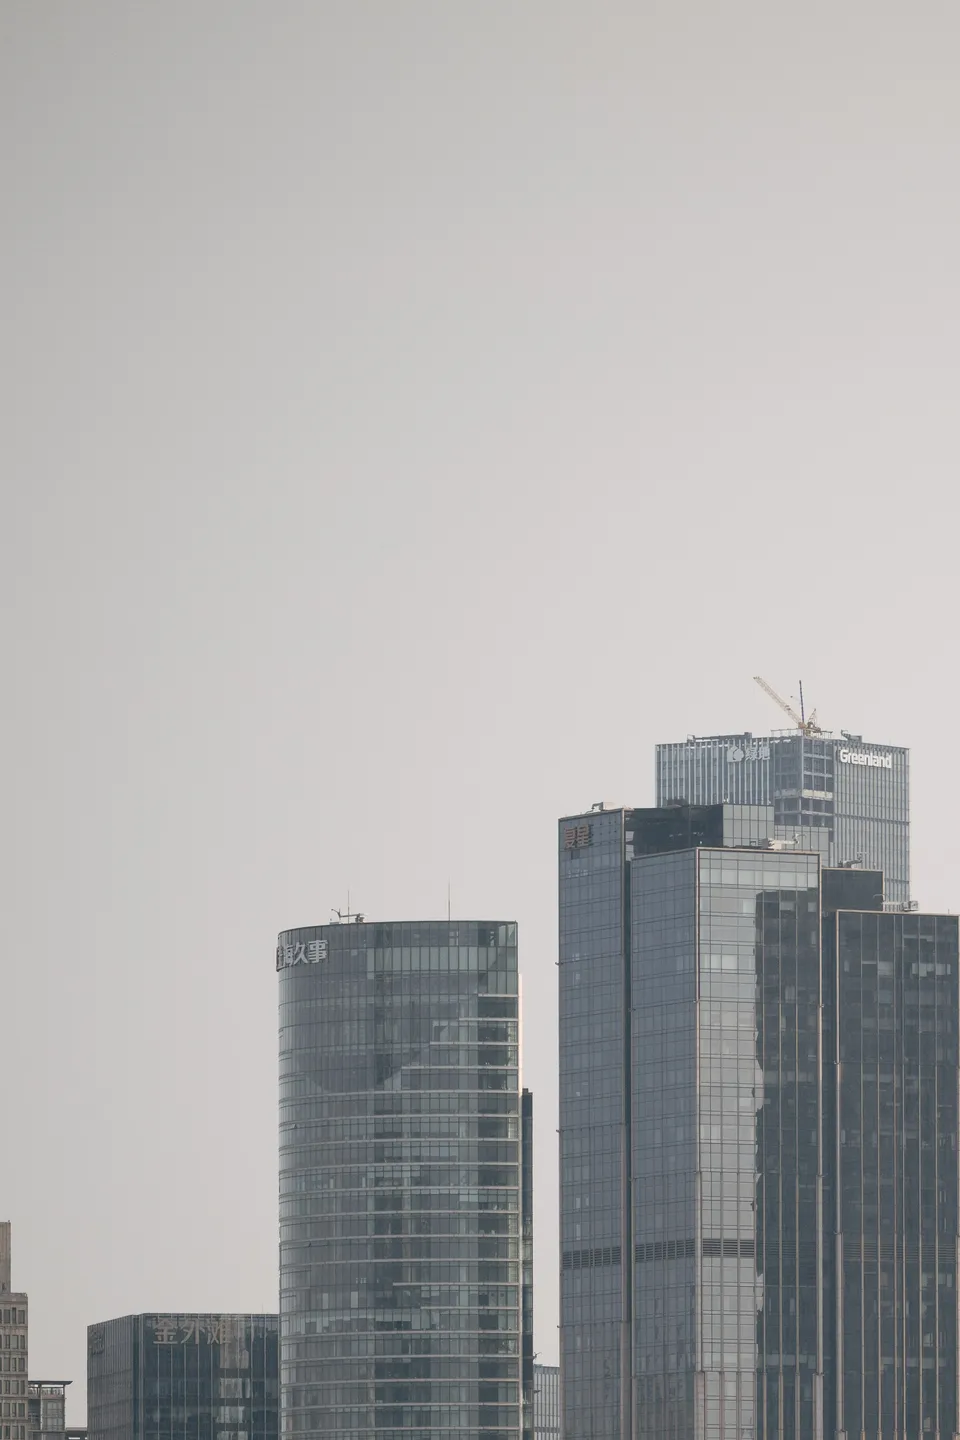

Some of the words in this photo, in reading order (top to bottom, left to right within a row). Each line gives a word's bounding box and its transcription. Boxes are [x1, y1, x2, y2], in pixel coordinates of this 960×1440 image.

[840, 749, 892, 768] Greenland
[152, 1317, 232, 1345] 金外滩
